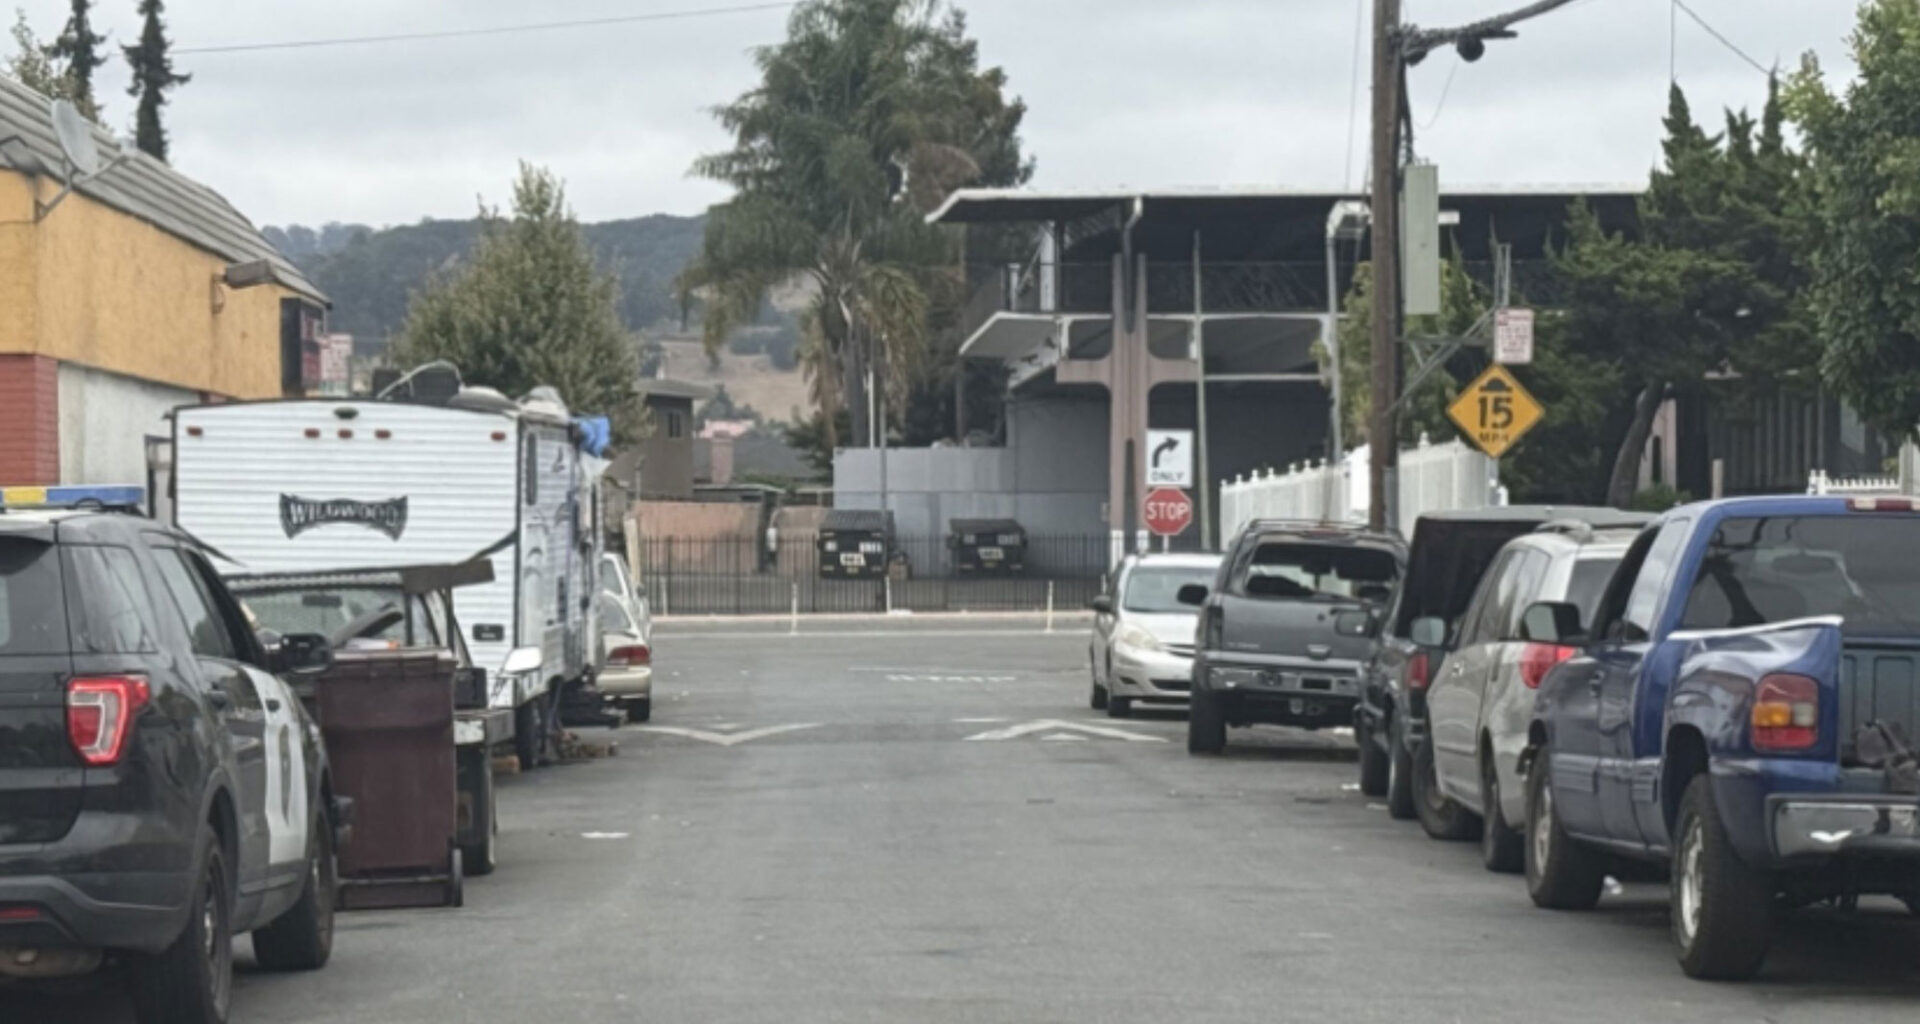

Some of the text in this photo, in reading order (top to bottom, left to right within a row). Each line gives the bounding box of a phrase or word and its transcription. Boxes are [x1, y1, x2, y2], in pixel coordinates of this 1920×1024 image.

[1478, 396, 1514, 429] 15
[1480, 432, 1509, 443] MPH
[1151, 471, 1184, 482] ONLY
[289, 501, 399, 527] WILDWOOD
[1146, 502, 1188, 520] STOP
